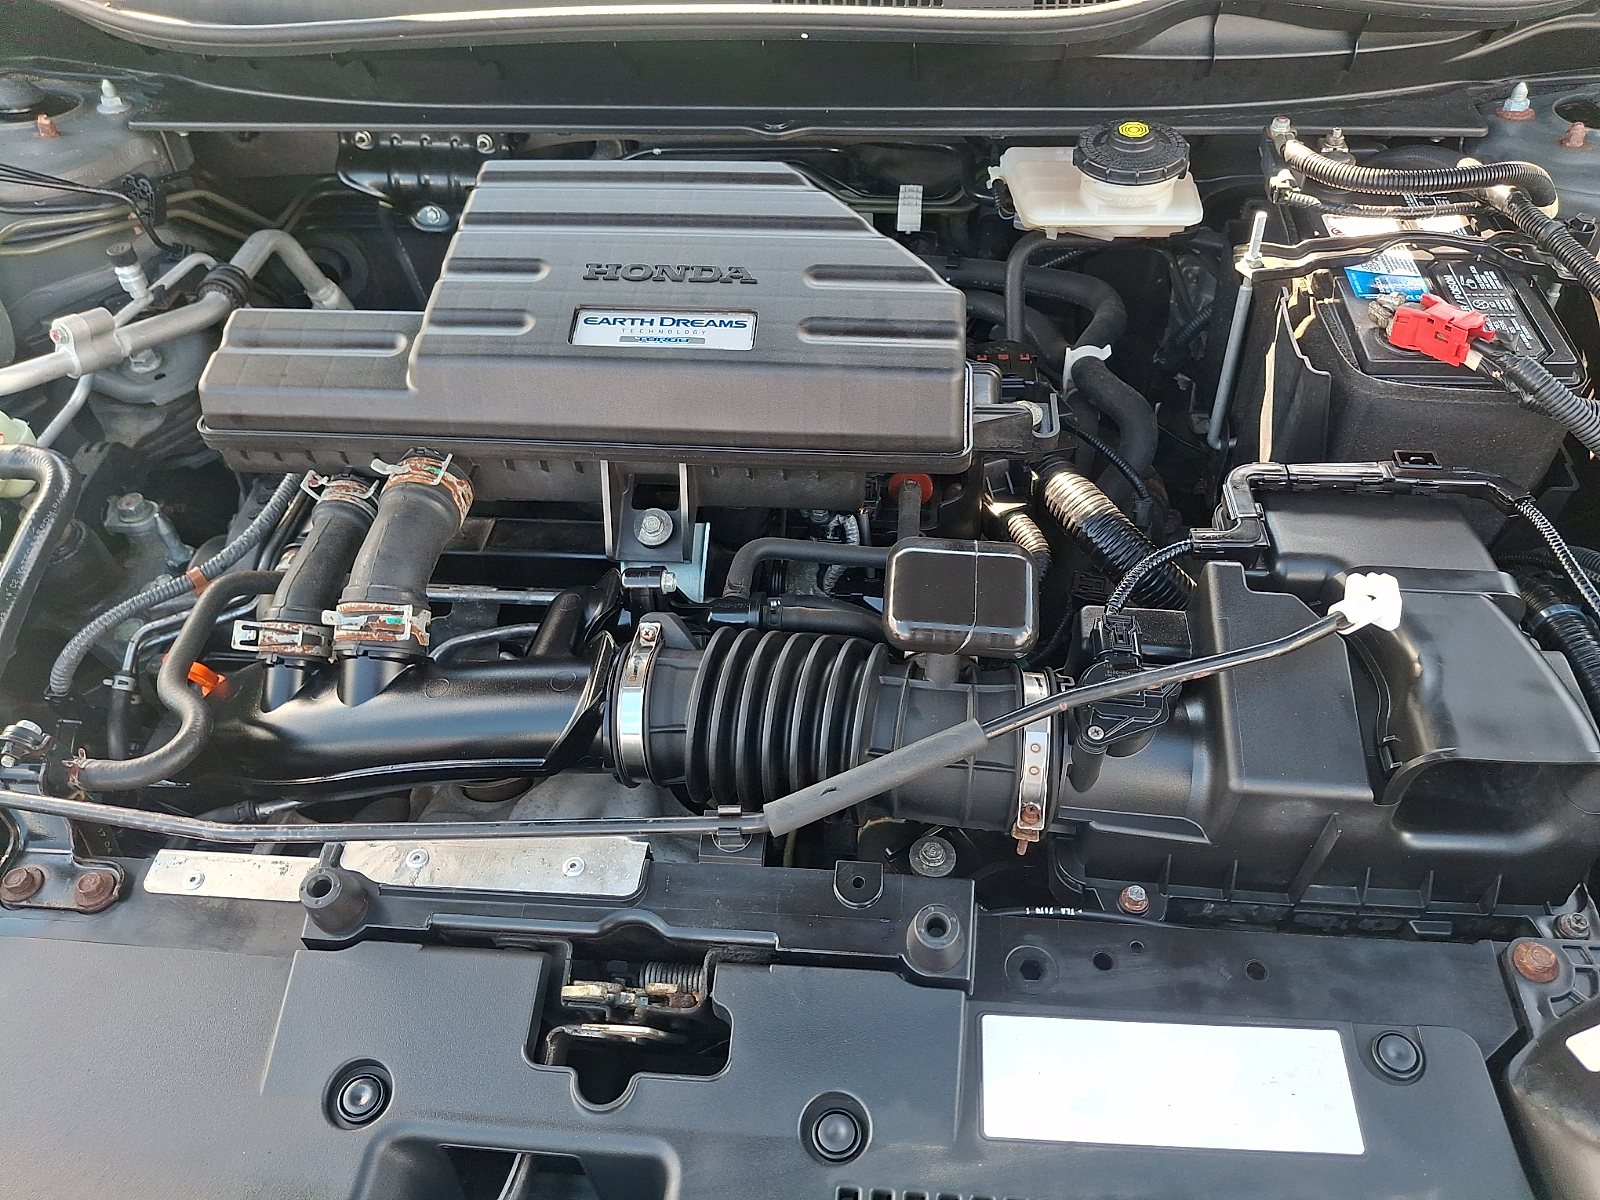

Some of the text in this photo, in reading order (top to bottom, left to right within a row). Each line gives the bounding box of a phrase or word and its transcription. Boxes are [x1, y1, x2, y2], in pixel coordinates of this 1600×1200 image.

[582, 263, 758, 285] HONDA
[1443, 274, 1465, 300] POISON
[583, 316, 748, 329] EARTH DREAMS
